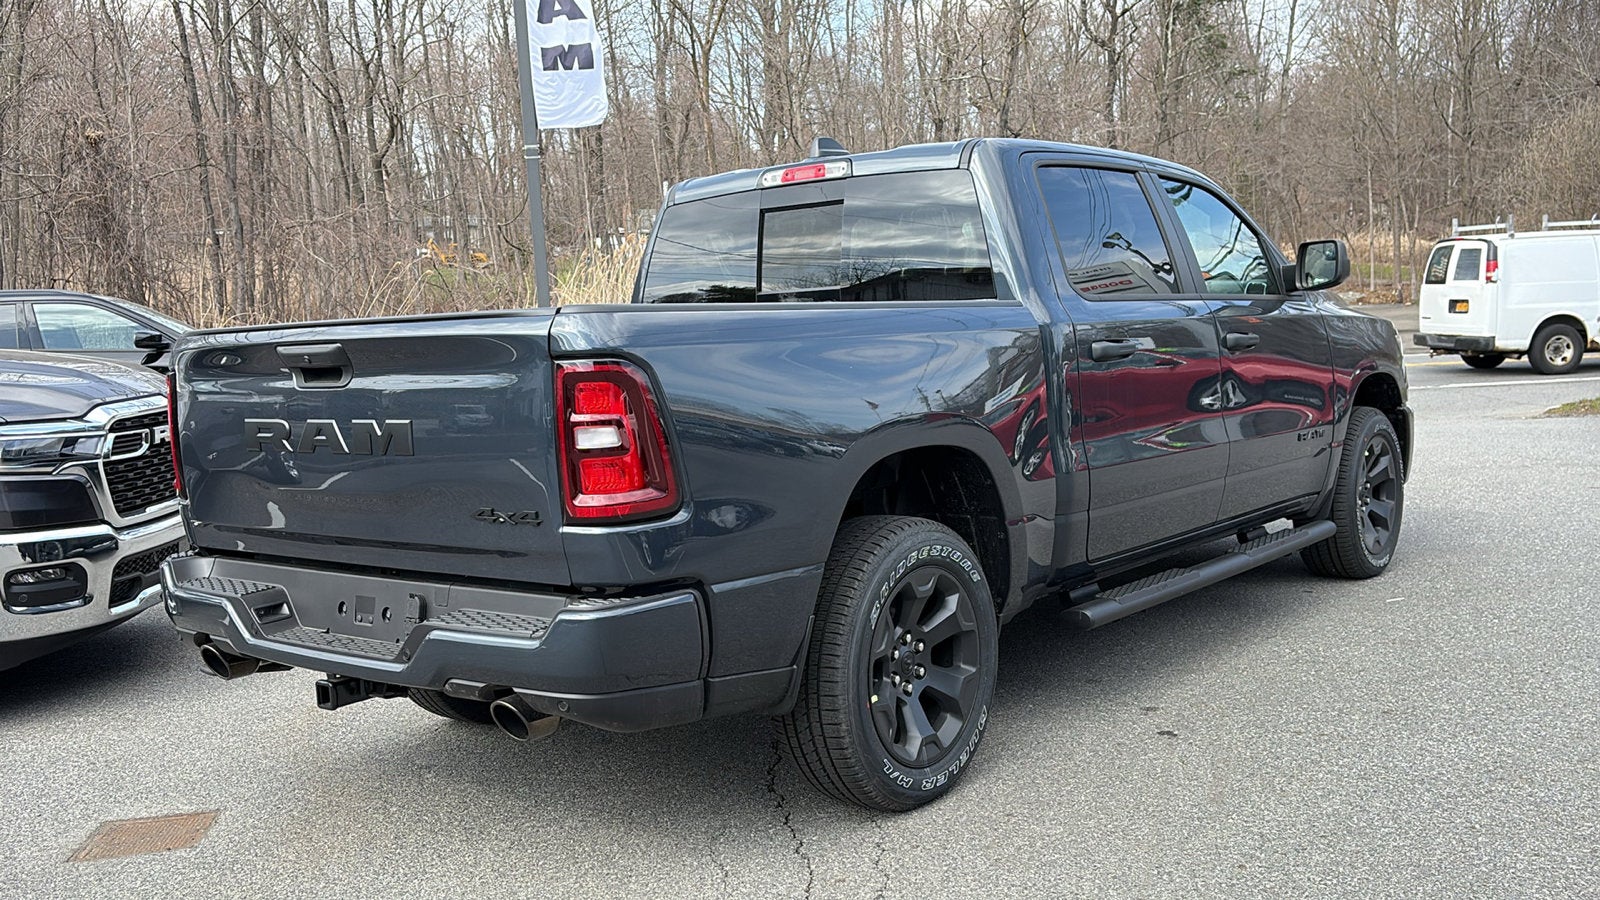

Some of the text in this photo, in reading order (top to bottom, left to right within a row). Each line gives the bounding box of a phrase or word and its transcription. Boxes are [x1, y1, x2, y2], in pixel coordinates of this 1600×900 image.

[244, 418, 415, 456] RAM
[1297, 429, 1326, 442] RAM
[869, 545, 981, 631] BRIDGESTONE
[883, 704, 988, 791] DUELER H/L
